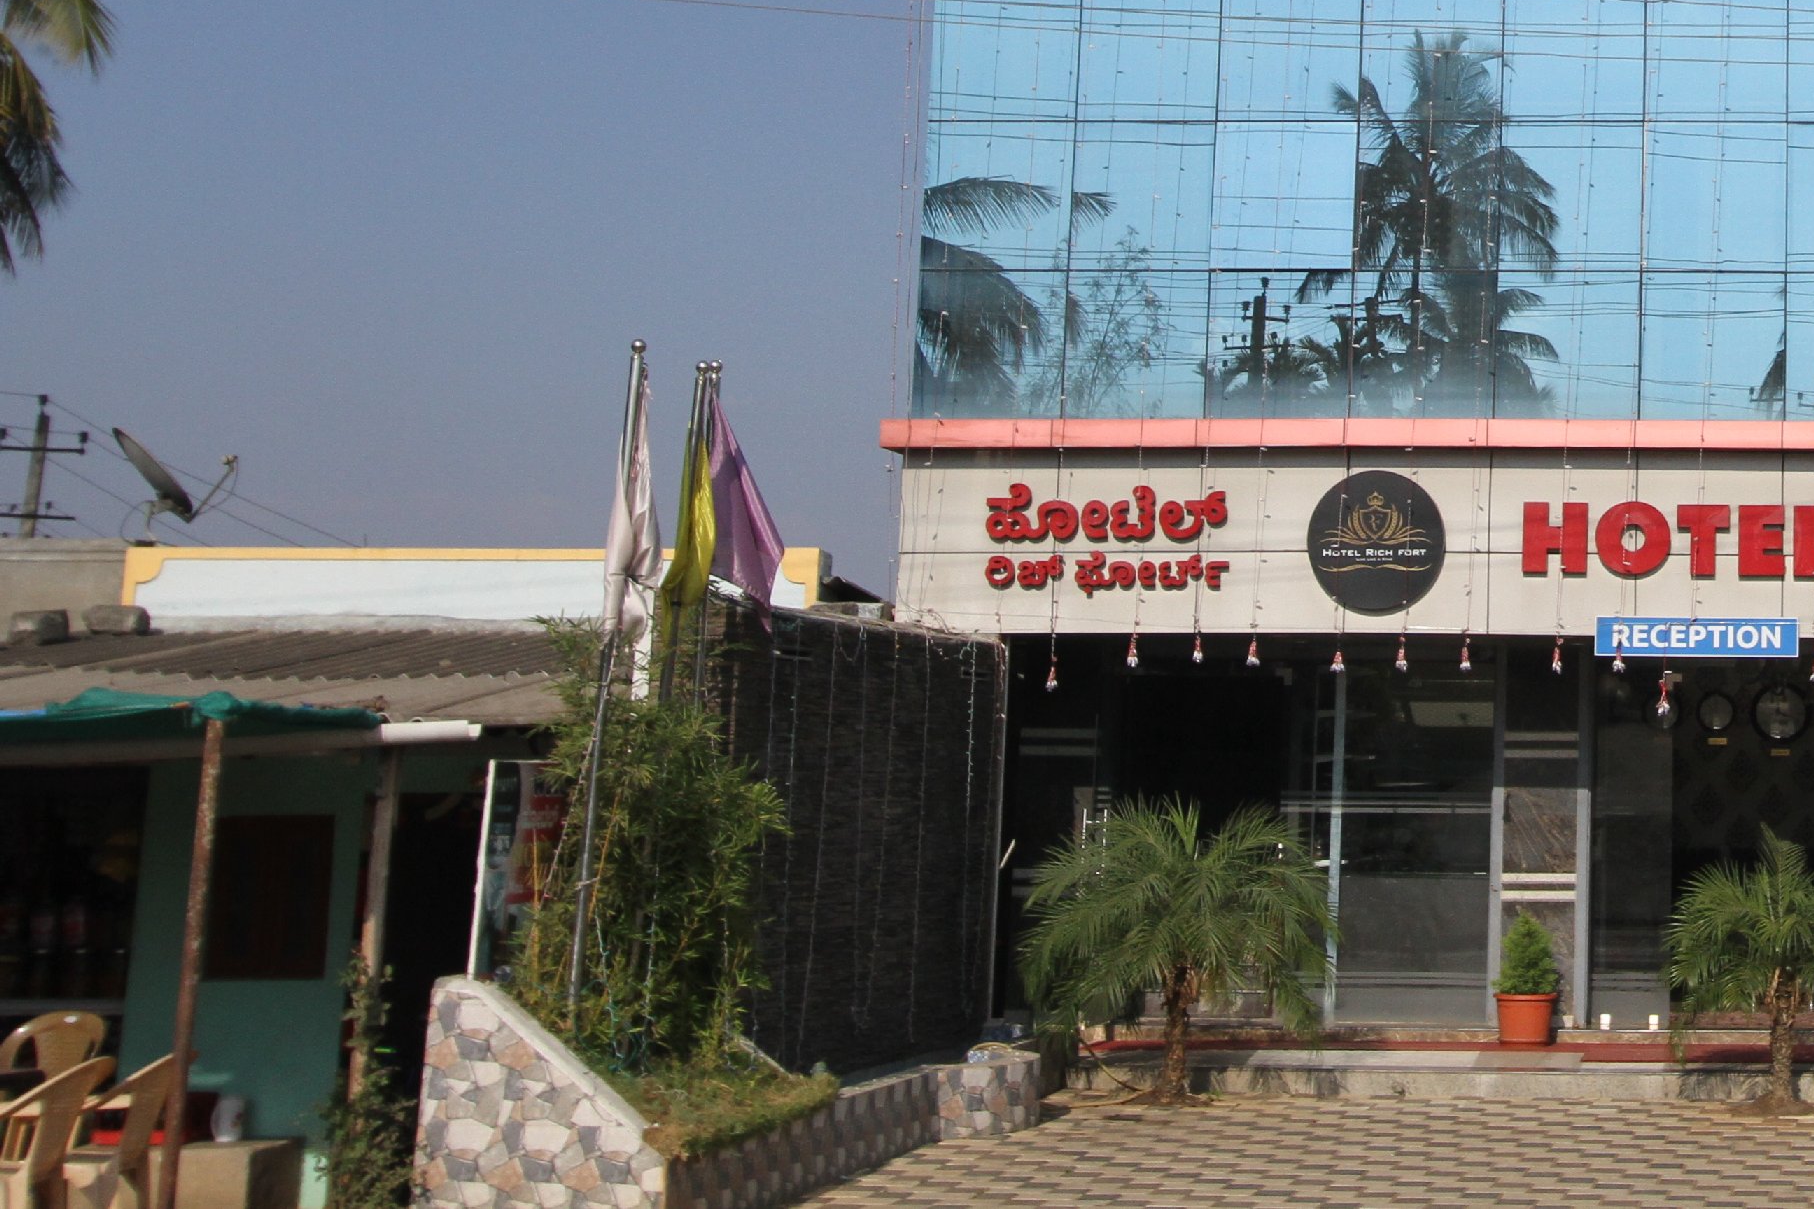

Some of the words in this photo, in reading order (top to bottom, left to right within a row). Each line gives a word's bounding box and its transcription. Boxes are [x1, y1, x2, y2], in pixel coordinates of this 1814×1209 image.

[986, 483, 1228, 539] ಹೋಟೆಲ್
[1322, 548, 1361, 557] HOTEL
[1366, 548, 1393, 557] RICH
[985, 555, 1064, 588] ರಿಚ್
[1075, 550, 1229, 597] ಫೋರ್ಟ್
[1611, 624, 1782, 649] RECEPTION
